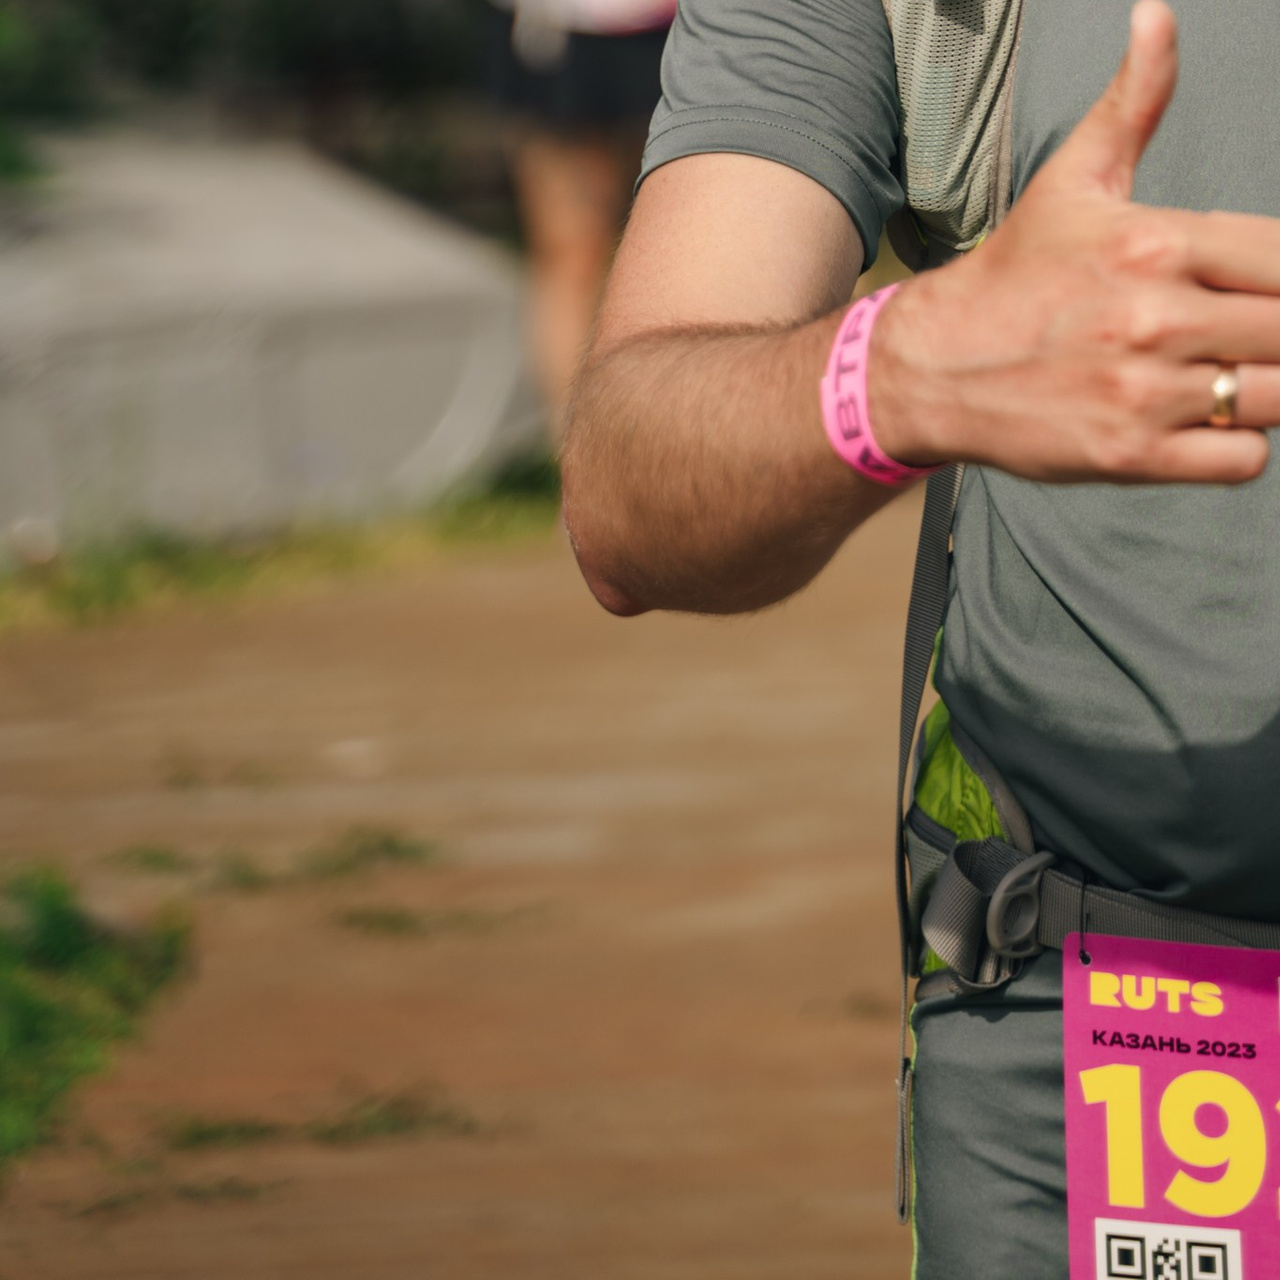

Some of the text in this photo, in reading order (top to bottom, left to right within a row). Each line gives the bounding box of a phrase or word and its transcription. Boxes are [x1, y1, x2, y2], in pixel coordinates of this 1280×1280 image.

[1089, 971, 1224, 1017] RUTS
[1091, 1029, 1257, 1060] КАЗАНЬ 2023
